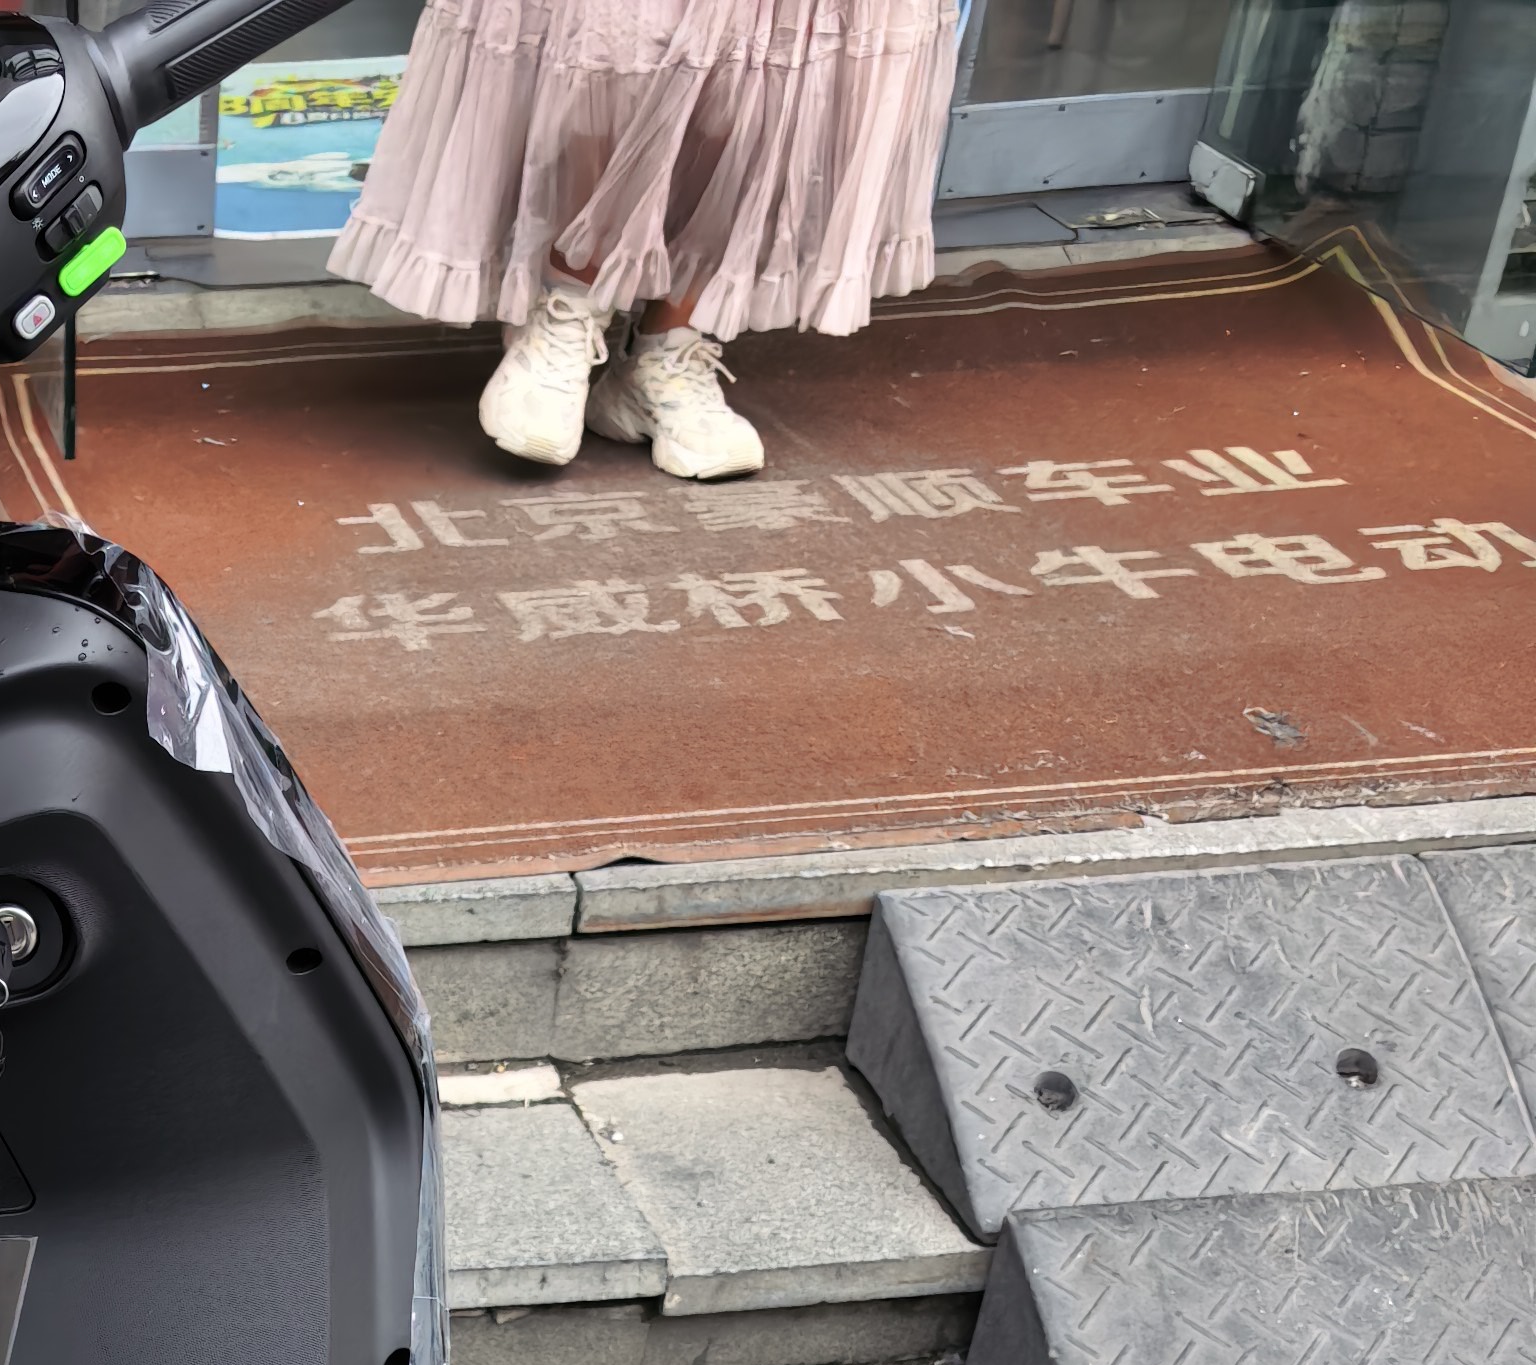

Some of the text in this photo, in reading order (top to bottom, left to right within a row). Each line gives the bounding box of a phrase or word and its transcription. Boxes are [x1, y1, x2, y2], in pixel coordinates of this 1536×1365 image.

[41, 164, 62, 188] MODE
[336, 446, 1352, 554] 北京豪顺车业
[312, 518, 1536, 651] 华威桥小牛电动
